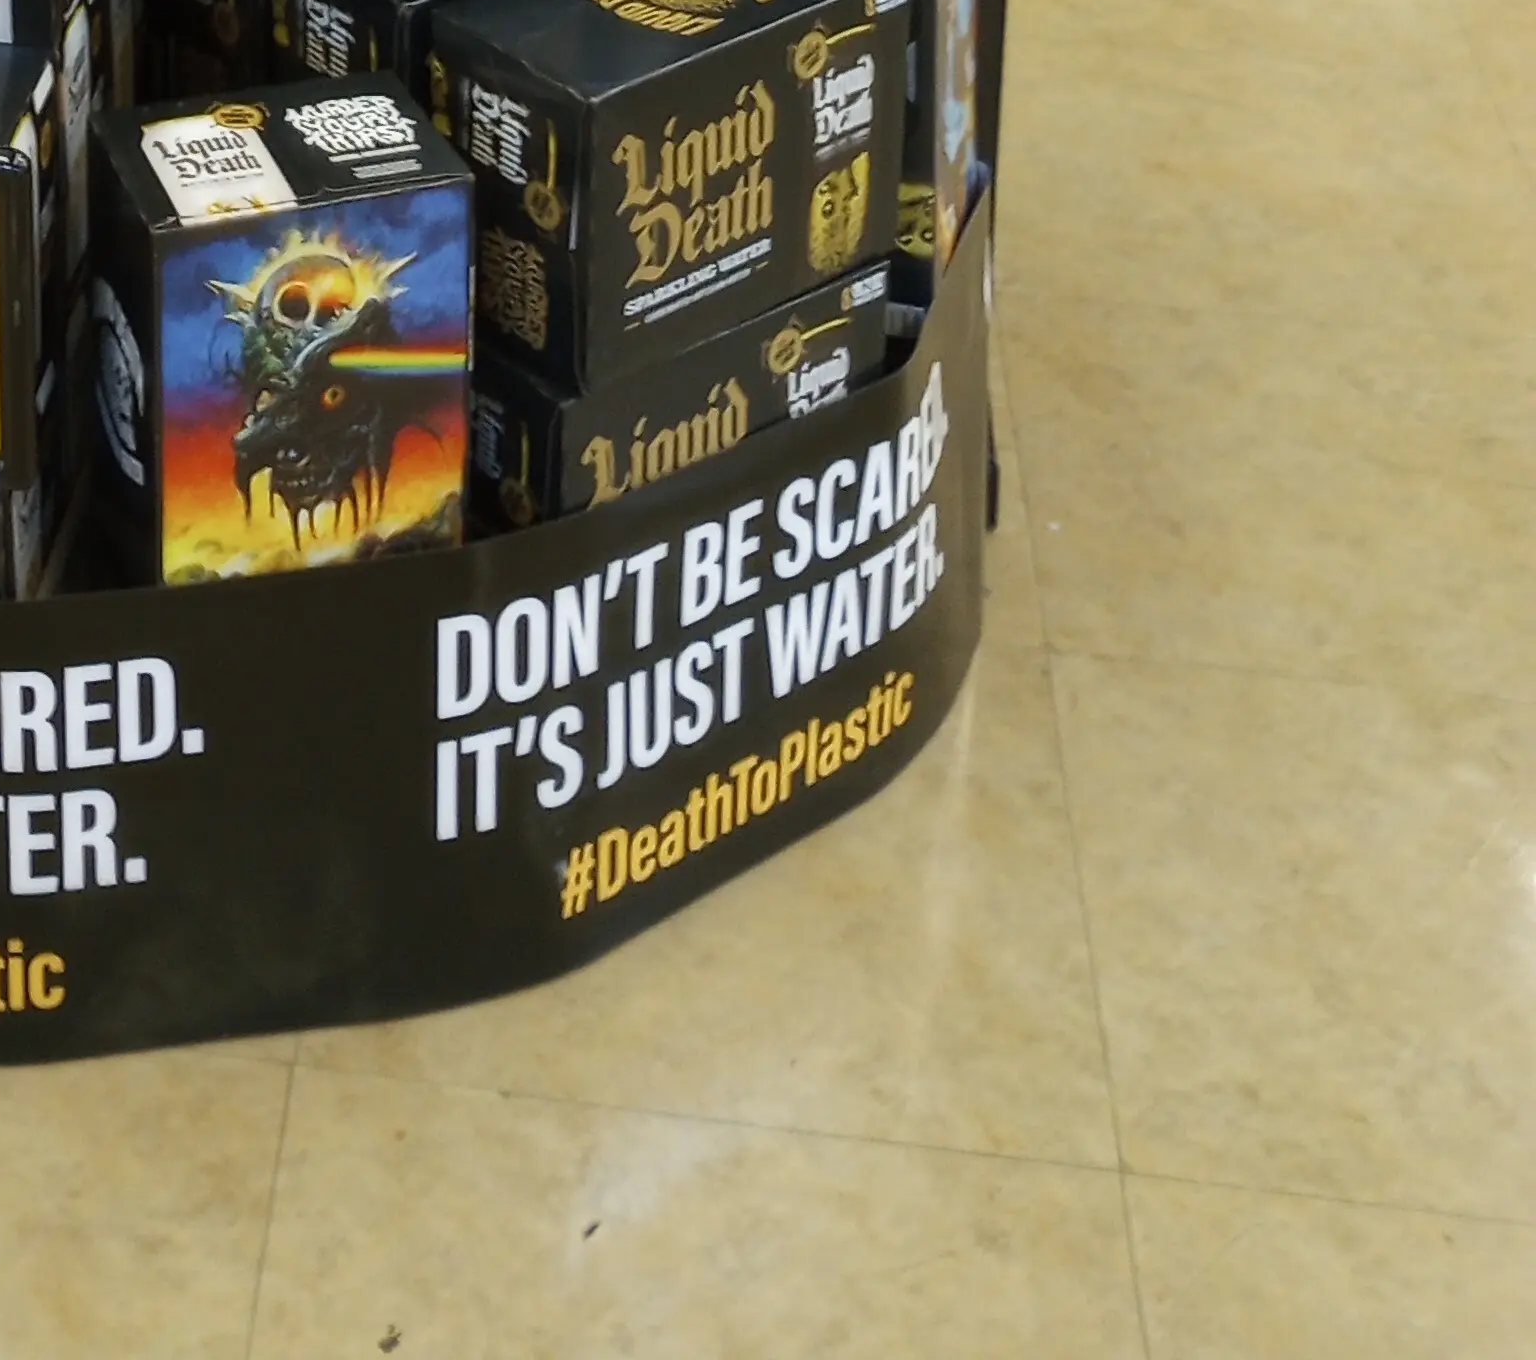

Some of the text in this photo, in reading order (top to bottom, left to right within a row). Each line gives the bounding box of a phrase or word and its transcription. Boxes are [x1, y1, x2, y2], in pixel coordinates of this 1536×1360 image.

[151, 129, 249, 161] Liquid
[283, 95, 396, 127] MURDER
[302, 116, 418, 155] THIRST
[469, 83, 501, 168] Death
[495, 97, 531, 185] Liquid
[612, 78, 778, 218] Liquid
[169, 150, 263, 180] Death
[625, 168, 775, 291] Death
[622, 254, 718, 318] SPARKLING
[580, 375, 751, 512] Liquid
[436, 497, 766, 722] DON'T BE
[435, 502, 946, 843] IT'S JUST WATER.
[558, 668, 917, 920] #DeathToPlastic
